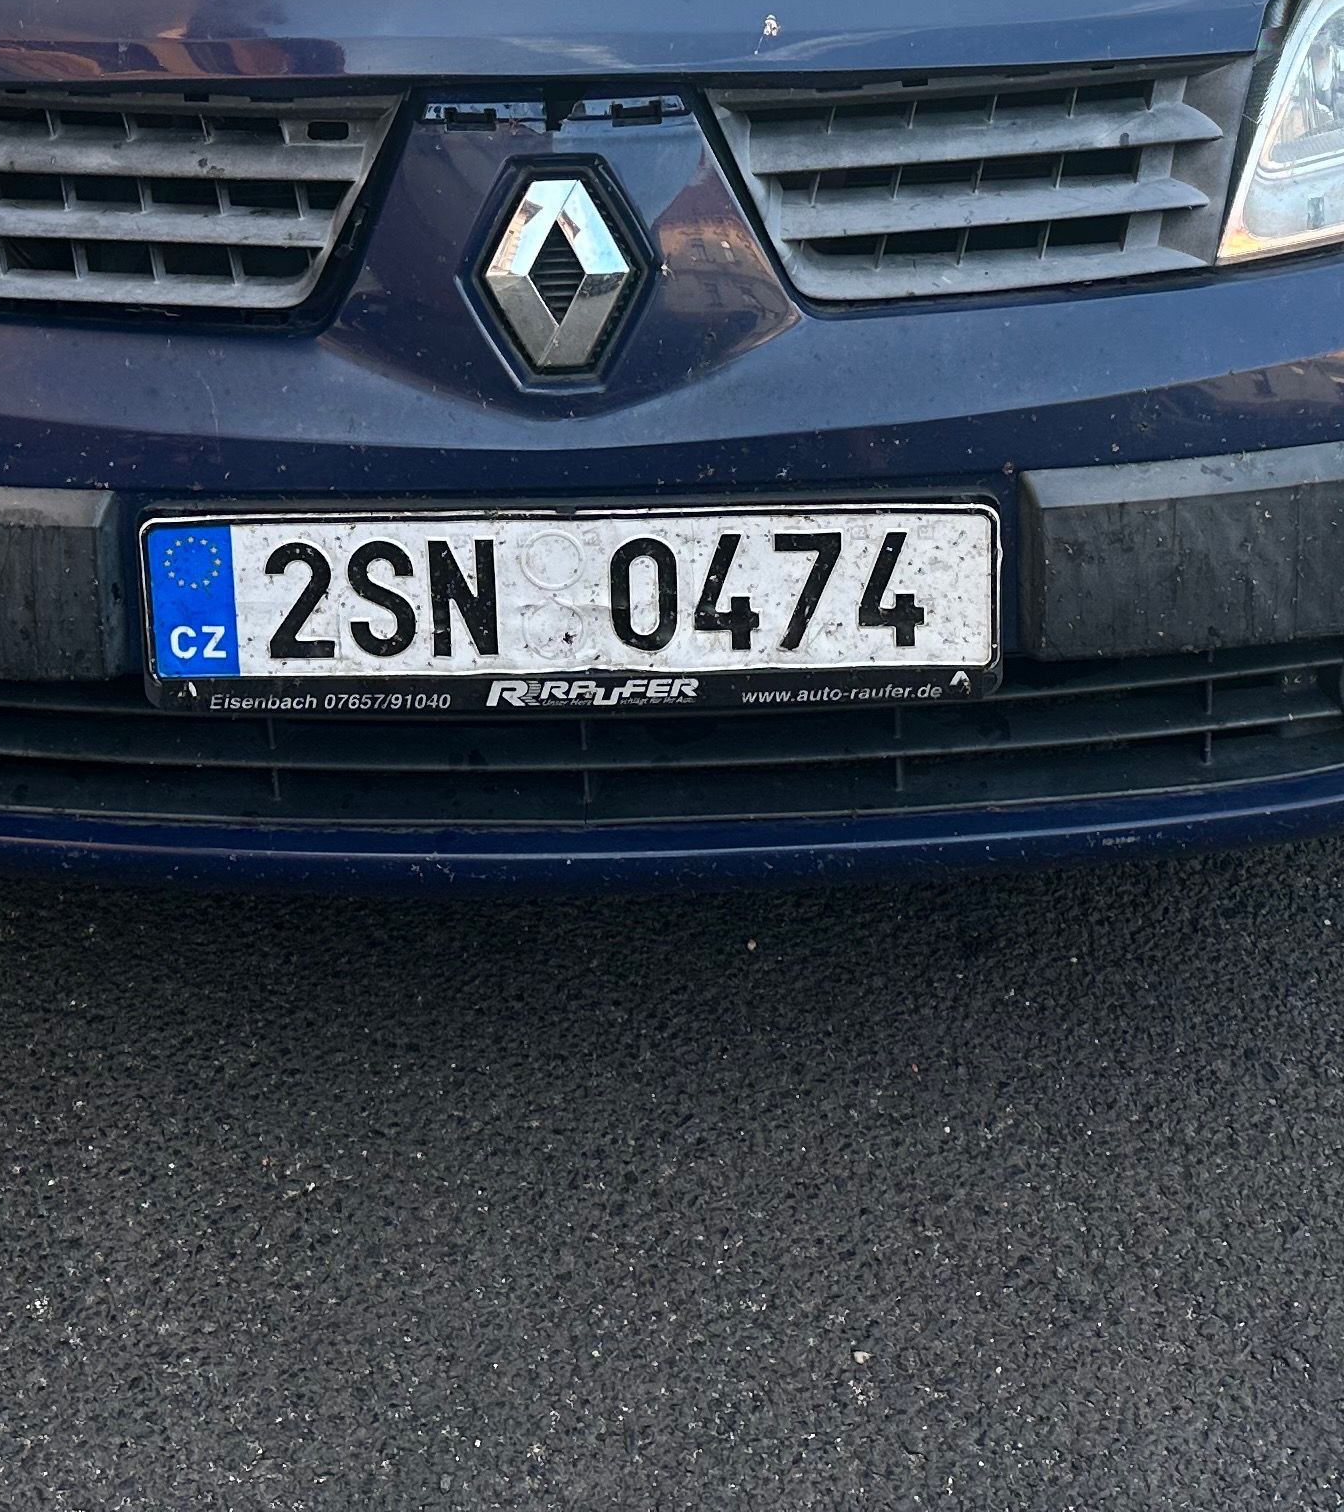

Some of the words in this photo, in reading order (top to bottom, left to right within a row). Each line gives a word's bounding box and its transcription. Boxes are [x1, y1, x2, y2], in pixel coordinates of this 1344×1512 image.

[264, 538, 500, 659] 2SN
[609, 531, 925, 652] 0474
[169, 625, 228, 660] CZ
[209, 693, 318, 710] Eisenbach
[323, 693, 452, 710] 07657/91040
[741, 683, 943, 704] www.auto-raufer.de
